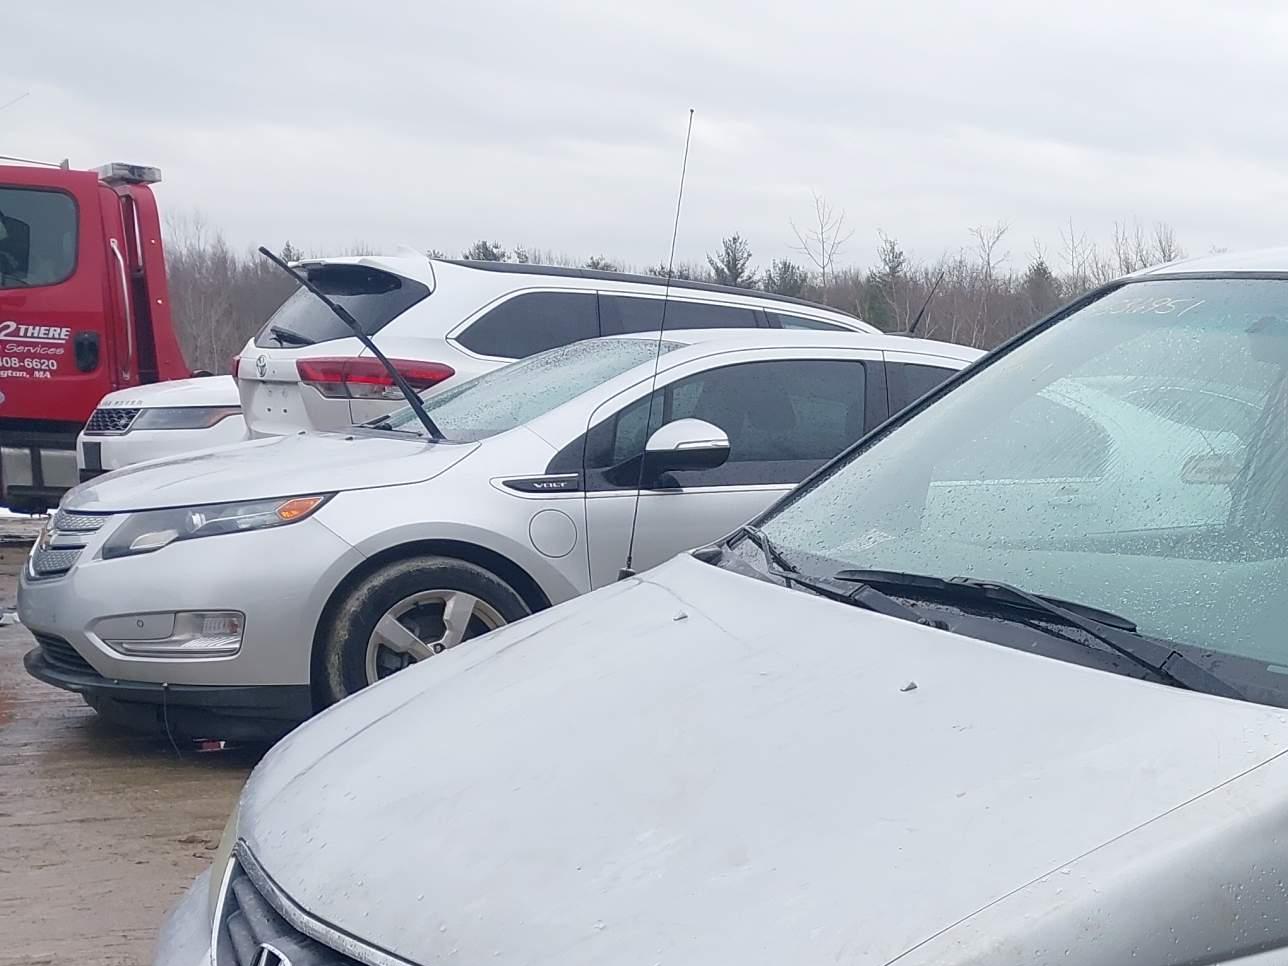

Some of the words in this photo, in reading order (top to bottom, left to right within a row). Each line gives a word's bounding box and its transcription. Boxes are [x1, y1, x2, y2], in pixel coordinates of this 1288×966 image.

[18, 325, 71, 339] THERE
[5, 344, 64, 355] Services
[0, 370, 29, 378] gton,
[33, 370, 51, 379] MA
